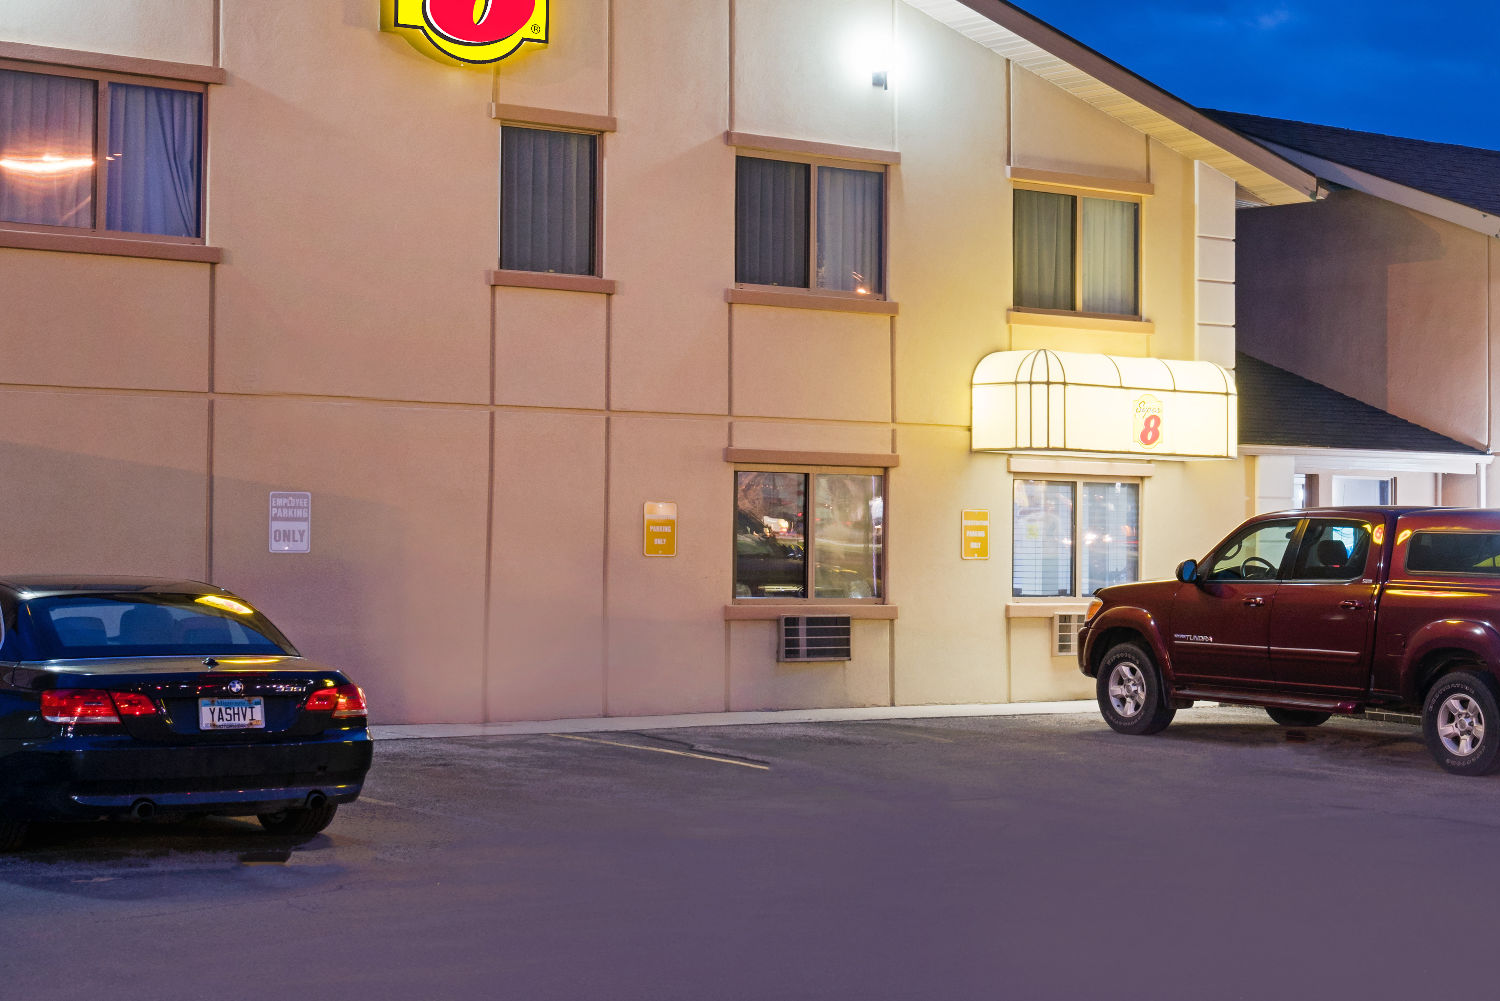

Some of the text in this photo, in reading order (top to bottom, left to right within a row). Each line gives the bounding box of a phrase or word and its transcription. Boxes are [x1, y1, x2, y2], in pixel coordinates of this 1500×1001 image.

[1136, 400, 1161, 419] Super
[1140, 414, 1161, 446] 8
[272, 497, 309, 507] EMPLOYEE
[272, 508, 309, 518] PARKING
[273, 529, 306, 543] ONLY
[1186, 634, 1213, 642] TUNDRA
[209, 706, 257, 722] YASHVI
